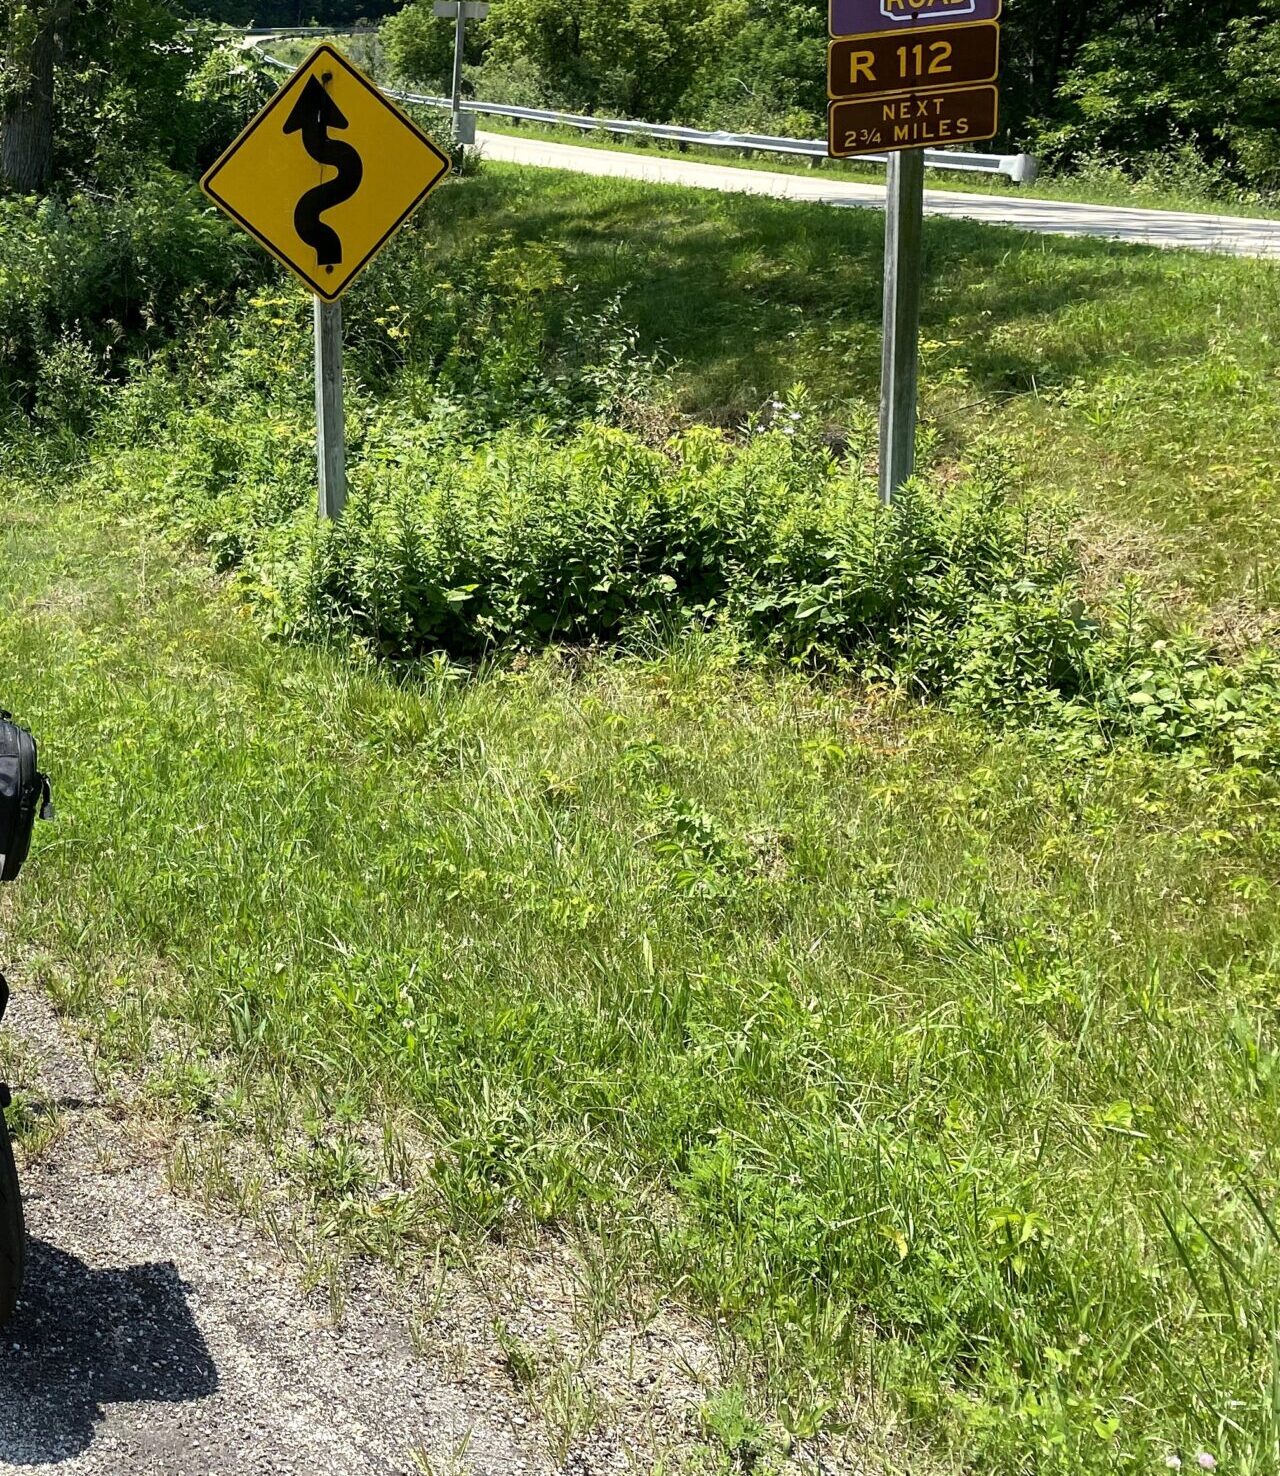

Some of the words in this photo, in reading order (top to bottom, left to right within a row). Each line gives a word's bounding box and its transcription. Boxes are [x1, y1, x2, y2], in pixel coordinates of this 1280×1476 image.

[850, 50, 877, 84] R
[897, 41, 953, 78] 112
[883, 98, 944, 121] NEXT
[894, 118, 969, 142] MILES
